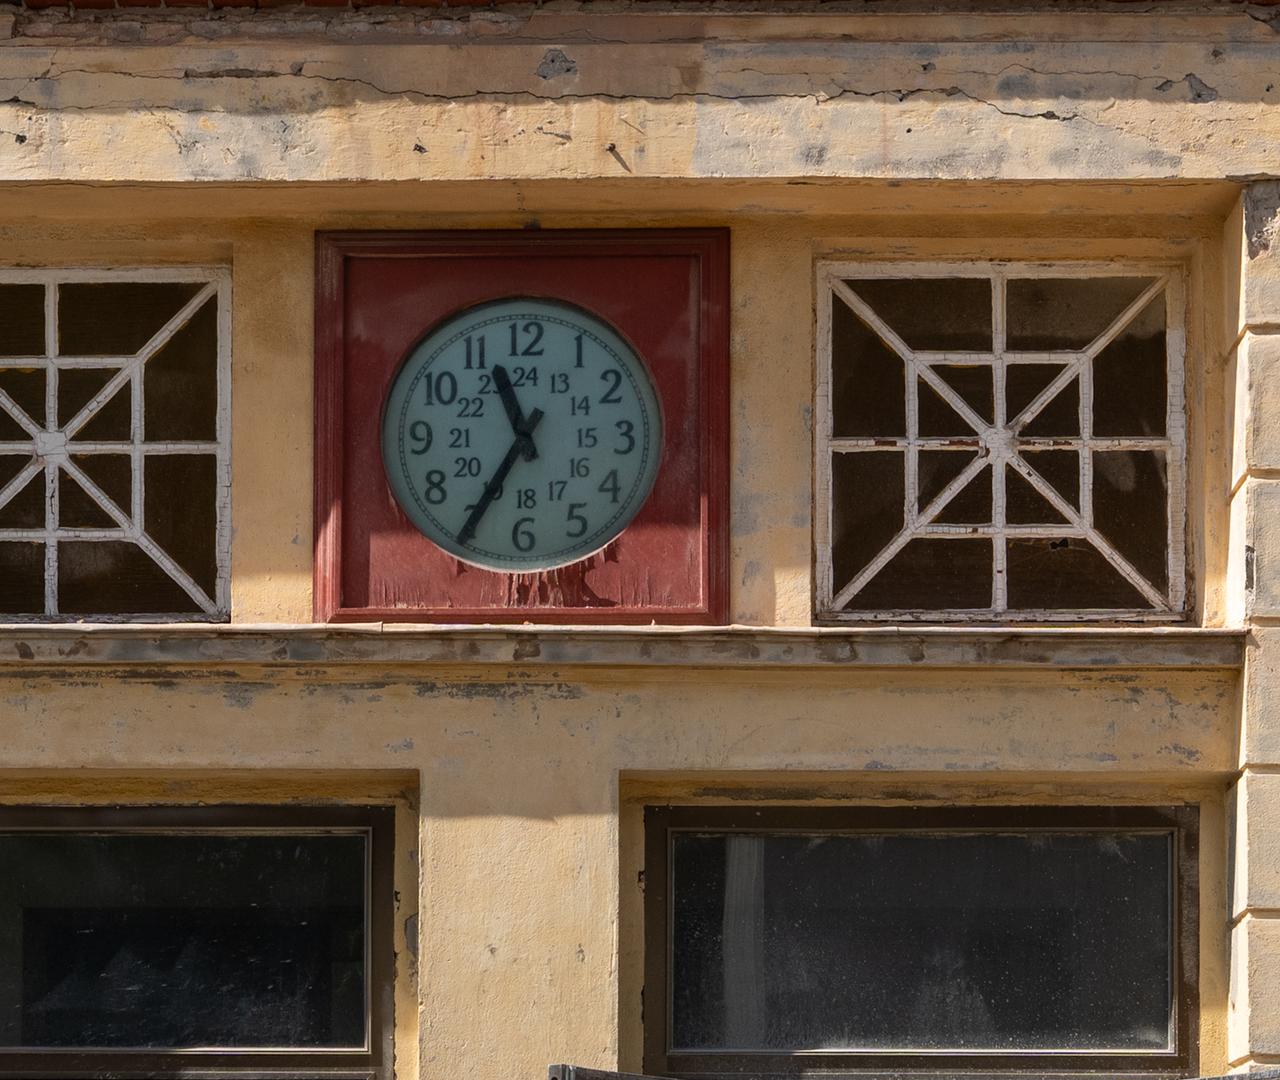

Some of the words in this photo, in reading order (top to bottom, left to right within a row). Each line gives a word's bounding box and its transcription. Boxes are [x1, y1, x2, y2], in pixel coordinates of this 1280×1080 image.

[509, 322, 544, 356] 12
[574, 334, 584, 368] 1
[463, 336, 485, 369] 11
[424, 372, 457, 405] 10
[479, 375, 503, 394] 2
[513, 367, 538, 387] 24
[550, 374, 569, 393] 13
[599, 370, 622, 403] 2
[457, 398, 484, 417] 22
[571, 397, 590, 415] 14
[410, 421, 432, 455] 9
[449, 429, 470, 448] 21
[577, 429, 597, 448] 15
[614, 421, 635, 454] 3
[454, 458, 480, 477] 20
[570, 458, 589, 477] 16
[424, 471, 447, 504] 8
[516, 490, 536, 508] 18
[548, 481, 567, 500] 17
[598, 470, 620, 503] 4
[567, 503, 587, 537] 5
[512, 517, 535, 552] 6
